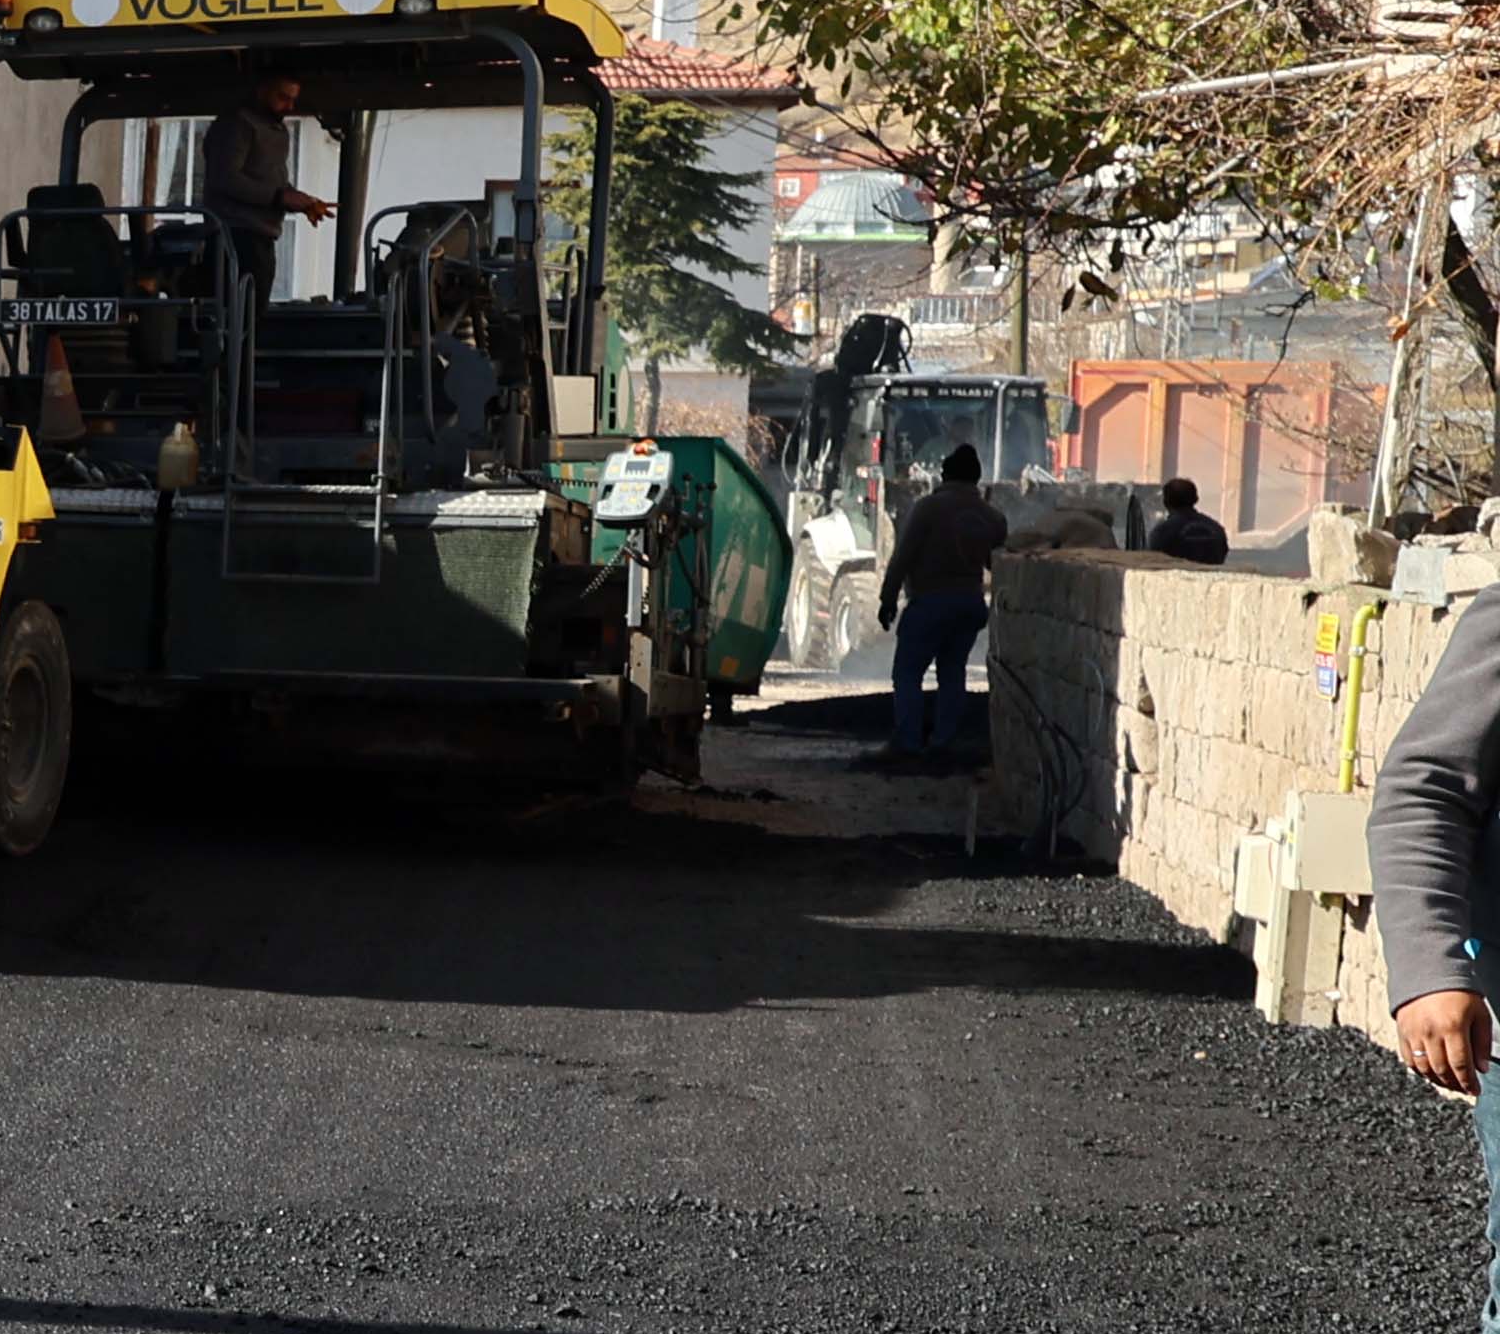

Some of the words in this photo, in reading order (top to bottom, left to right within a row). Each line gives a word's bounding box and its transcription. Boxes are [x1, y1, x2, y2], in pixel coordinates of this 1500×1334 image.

[8, 301, 31, 321] 38
[34, 301, 88, 321] TALAS
[93, 301, 113, 321] 17
